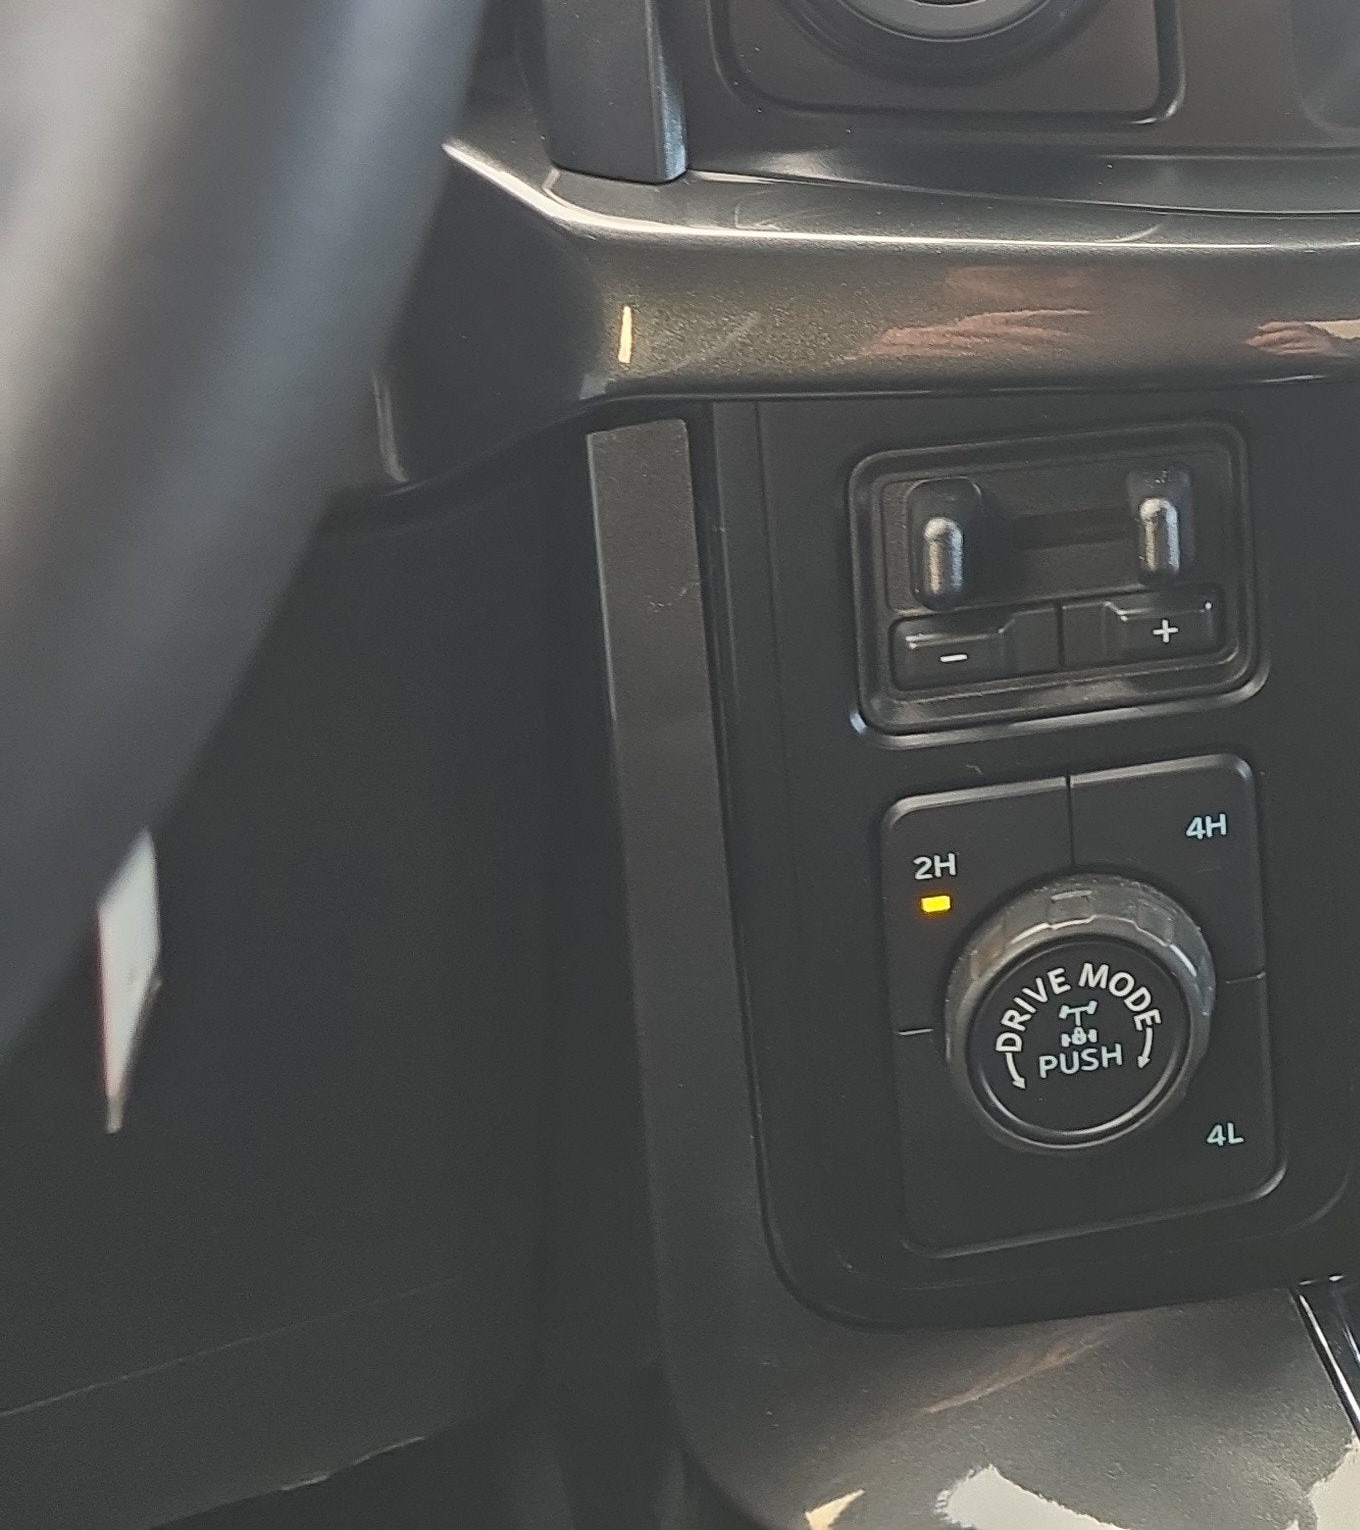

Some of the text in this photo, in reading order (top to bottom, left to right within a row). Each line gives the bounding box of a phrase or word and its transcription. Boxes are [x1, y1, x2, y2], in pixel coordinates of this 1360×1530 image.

[1185, 813, 1228, 840] 4H
[912, 853, 958, 881] 2H
[994, 962, 1162, 1053] DRIVE MODE
[1038, 1044, 1124, 1079] PUSH
[1206, 1123, 1245, 1147] 4L
